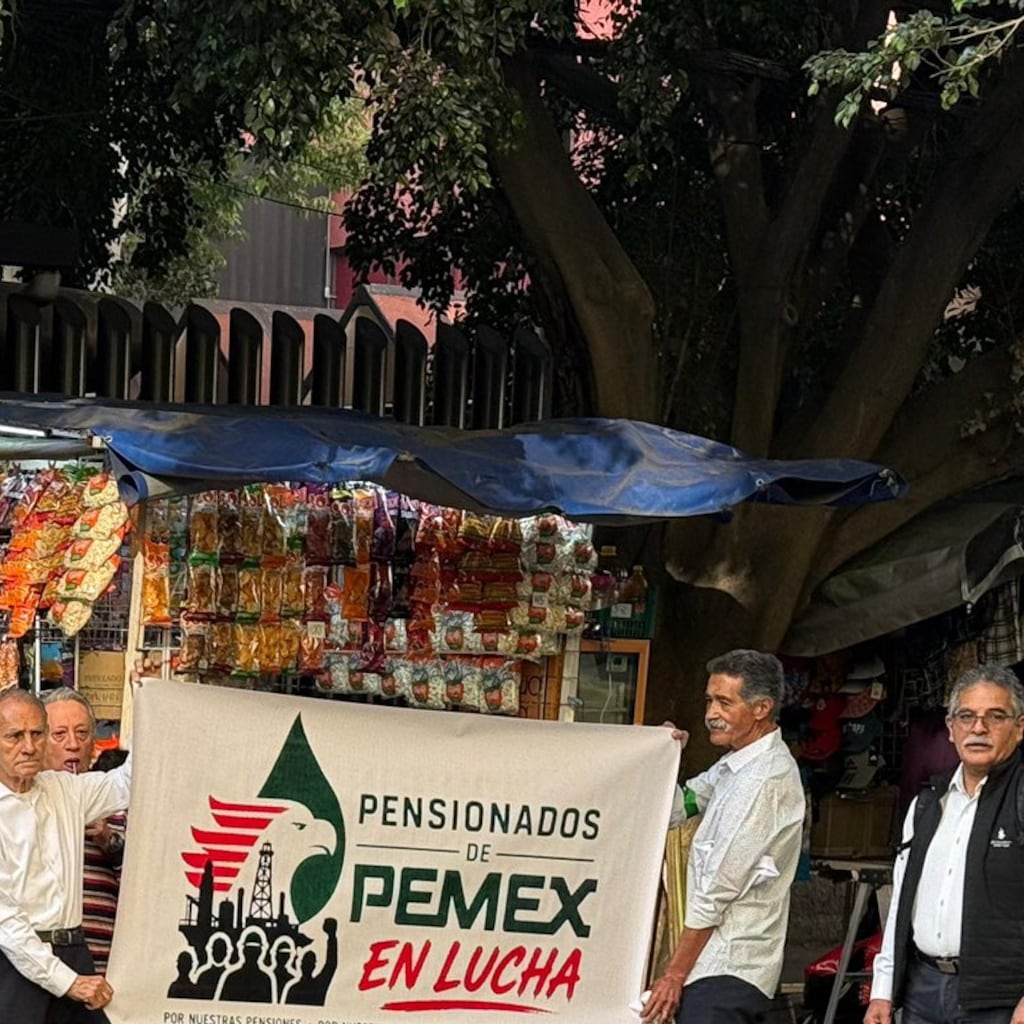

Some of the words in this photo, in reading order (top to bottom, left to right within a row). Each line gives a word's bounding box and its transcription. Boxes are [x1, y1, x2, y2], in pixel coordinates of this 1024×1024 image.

[359, 794, 601, 840] PENSIONADOS
[466, 843, 492, 863] DE
[350, 864, 598, 938] PEMEX
[358, 939, 432, 992] EN
[433, 941, 582, 1002] LUCHA
[163, 1012, 184, 1024] POR
